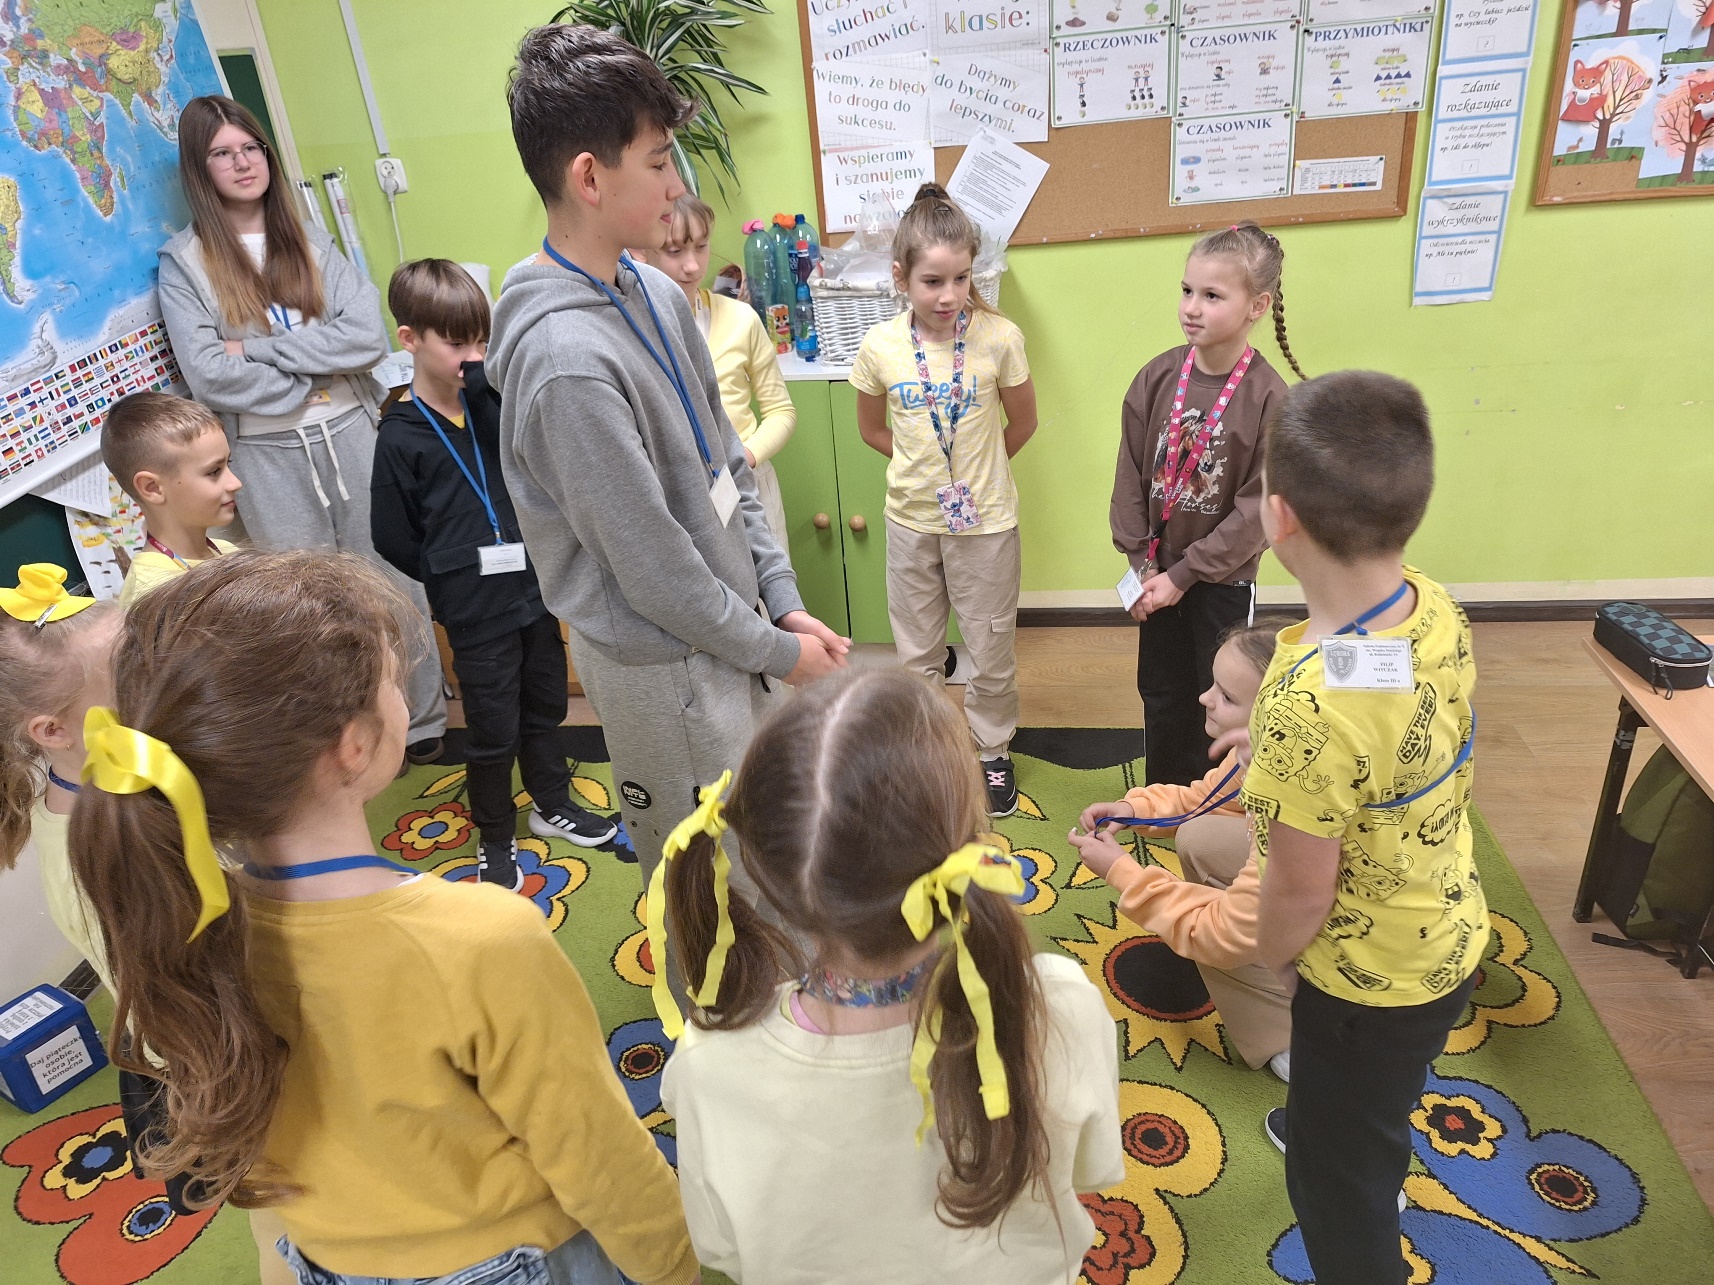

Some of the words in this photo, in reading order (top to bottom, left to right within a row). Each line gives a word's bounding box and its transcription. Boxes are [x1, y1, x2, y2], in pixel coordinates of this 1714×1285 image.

[944, 6, 1031, 35] klasie:
[824, 15, 926, 61] rozmawiać.
[1190, 29, 1278, 48] CZASOWNIK
[1314, 21, 1425, 42] PRZYMIOTNIKI
[1063, 33, 1159, 53] RZECZOWNIK
[869, 76, 884, 89] że
[967, 63, 1020, 93] Dążymy
[1460, 80, 1501, 94] Zdanie
[828, 91, 842, 104] to
[846, 94, 889, 112] droga
[893, 99, 911, 113] do
[934, 73, 954, 89] do
[957, 80, 1000, 105] bycia
[1002, 98, 1045, 122] coraz
[1446, 97, 1512, 113] rozkazujące
[837, 114, 897, 131] sukcesu.
[949, 98, 1015, 133] lepszymi.
[1186, 118, 1272, 135] CZASOWNIK
[837, 149, 916, 168] Wspieramy
[835, 173, 840, 187] i
[844, 167, 926, 185] szanujemy
[1448, 200, 1481, 211] Zdanie
[1428, 213, 1499, 229] wykrzyknikowe
[1420, 696, 1434, 730] EVER!
[1399, 729, 1416, 754] HAVE
[1413, 713, 1424, 728] THE
[29, 1054, 45, 1069] Daj
[42, 1063, 66, 1079] która
[67, 1051, 83, 1066] jest
[47, 1058, 84, 1084] pomocna
